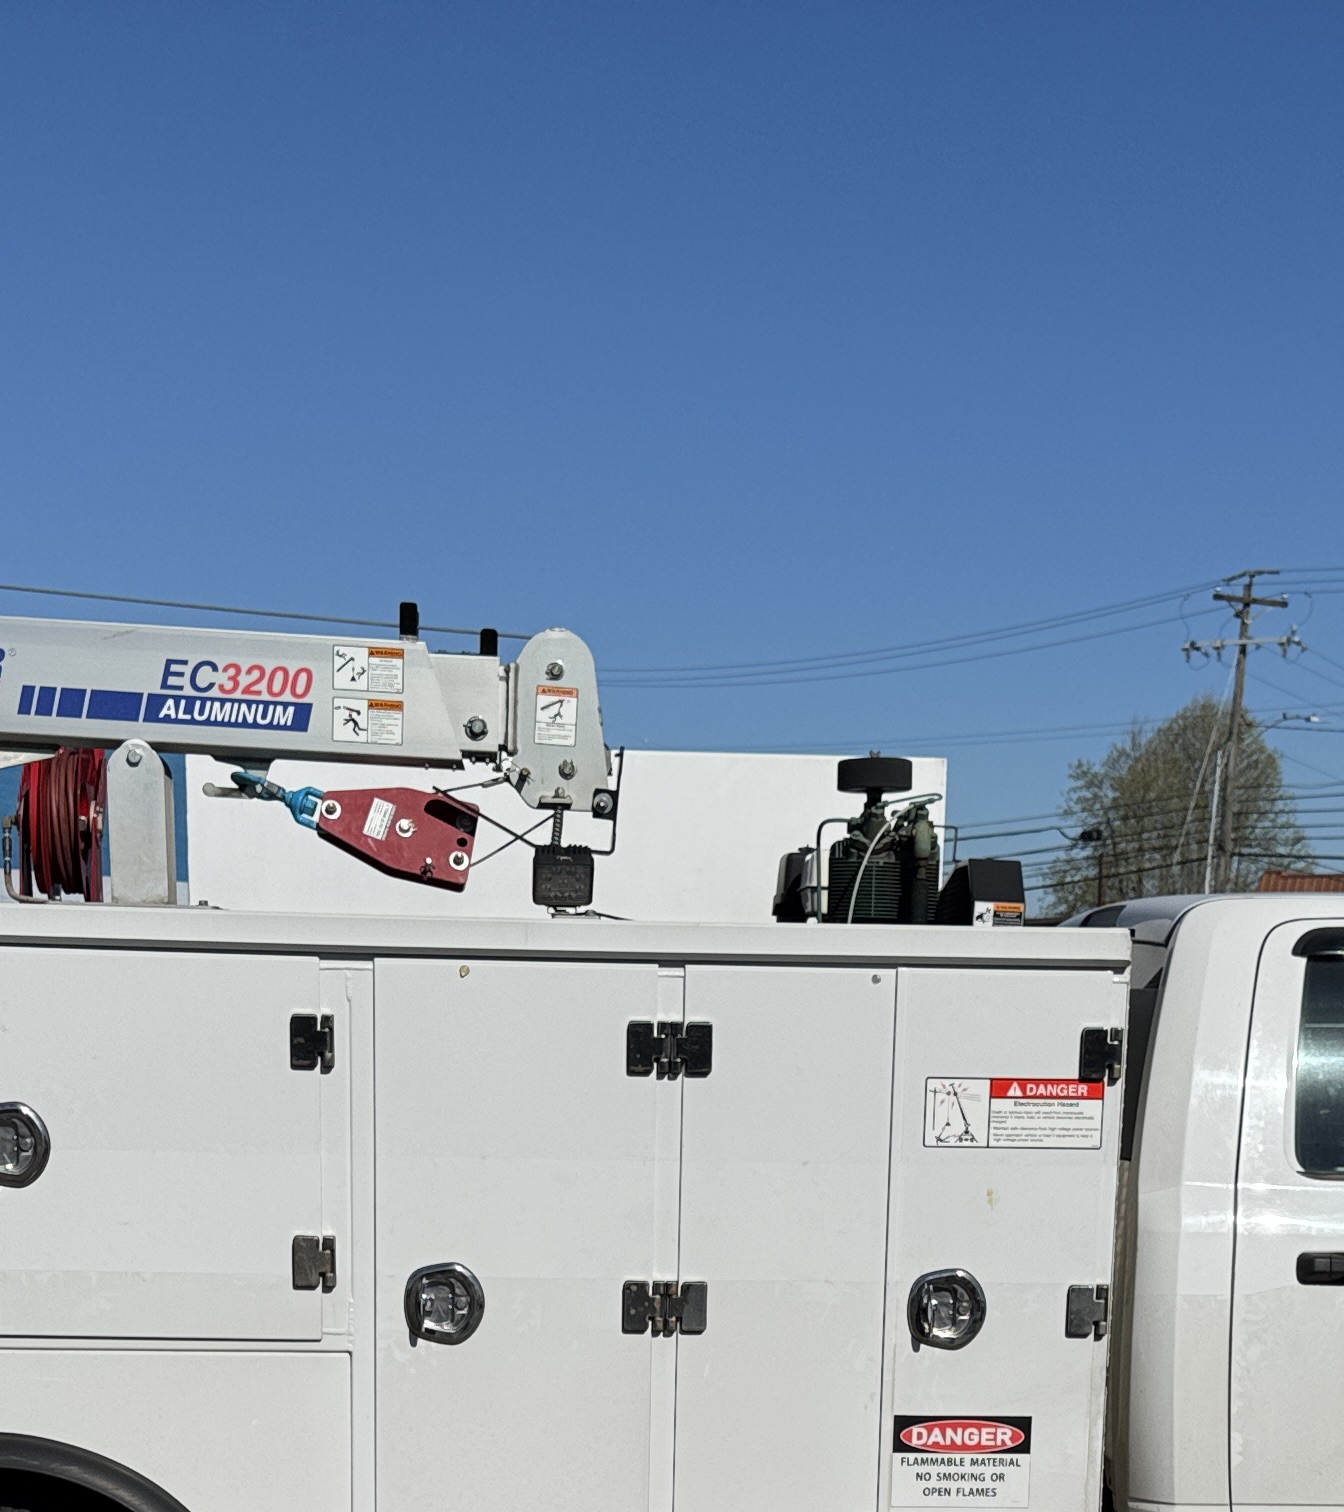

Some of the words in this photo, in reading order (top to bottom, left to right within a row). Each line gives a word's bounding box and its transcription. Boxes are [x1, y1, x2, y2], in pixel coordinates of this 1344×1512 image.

[160, 658, 313, 699] EC3200
[158, 698, 295, 727] ALUMINUM
[1026, 1083, 1088, 1097] DANGER
[911, 1427, 1013, 1446] DANGER
[901, 1457, 965, 1467] FLAMMABLE
[970, 1457, 1021, 1468] MATERIAL
[916, 1472, 931, 1482] NO
[936, 1472, 985, 1482] SMOKING
[990, 1472, 1005, 1482] OR
[922, 1487, 951, 1497] OPEN
[956, 1487, 997, 1498] FLAMES
